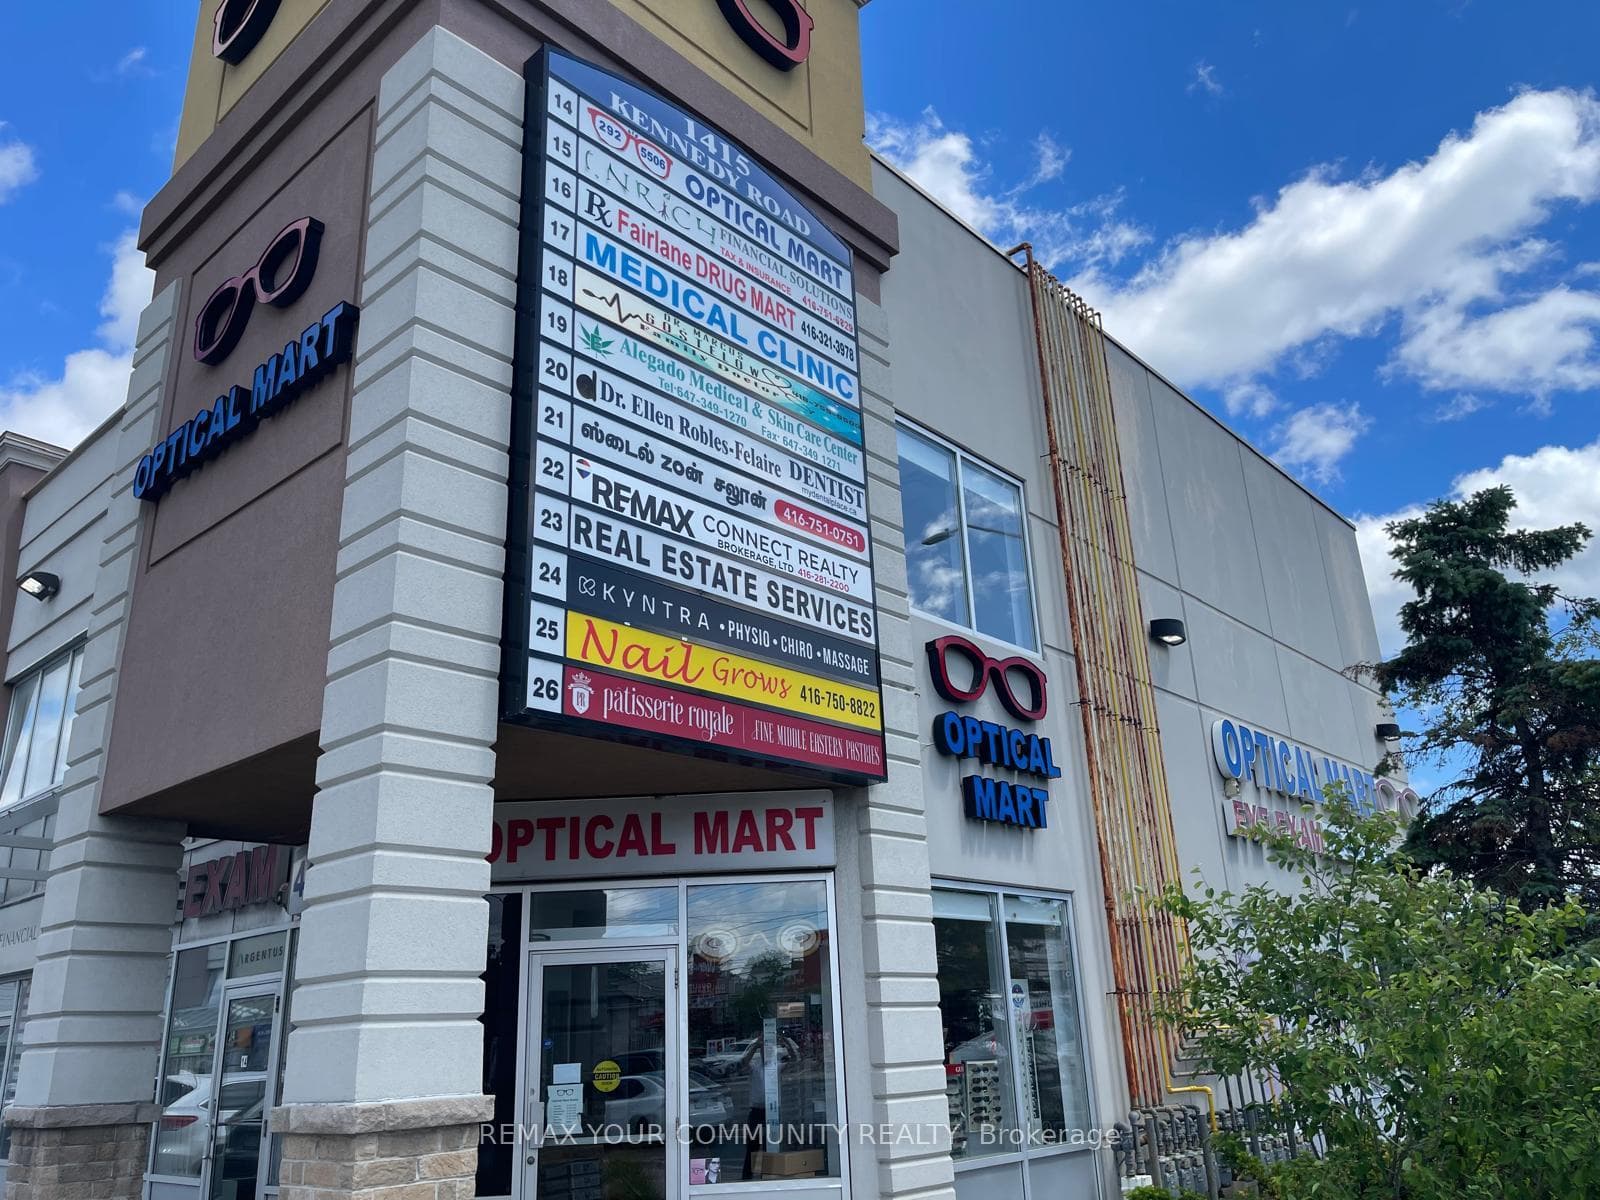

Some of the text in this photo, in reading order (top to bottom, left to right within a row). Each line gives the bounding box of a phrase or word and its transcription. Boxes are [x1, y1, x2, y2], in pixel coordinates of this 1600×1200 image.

[554, 93, 572, 115] 14
[553, 136, 571, 158] 15
[599, 120, 621, 141] 292
[641, 147, 666, 170] 5506
[610, 91, 810, 236] KENNEDY ROAD
[685, 117, 750, 177] 1415
[553, 177, 571, 199] 16
[551, 220, 570, 241] 17
[685, 174, 842, 289] OPTICAL MART
[549, 265, 568, 286] 18
[617, 209, 692, 271] Fairlane
[696, 254, 747, 303] DRUG
[751, 286, 796, 331] MART
[720, 246, 736, 263] TAX
[738, 257, 745, 267] &
[746, 262, 792, 296] INSURANCE
[720, 228, 787, 279] FINANCIAL
[790, 271, 853, 320] SOLUTIONS
[548, 312, 567, 333] 19
[586, 233, 853, 399] MEDICAL CLINIC
[545, 358, 568, 381] 20
[133, 301, 350, 498] OPTICAL MART
[544, 406, 563, 429] 21
[620, 338, 858, 465] Alegado Medical & Skin Care Center
[542, 457, 564, 480] 22
[600, 380, 864, 509] Dr. Ellen Robles-Felaire DENTIST
[541, 509, 562, 532] 23
[784, 507, 859, 548] 416-751-0751
[539, 562, 561, 585] 24
[703, 515, 792, 561] CONNECT
[798, 549, 859, 584] REALTY
[574, 513, 872, 638] REAL ESTATE SERVICES
[778, 560, 794, 573] LTD
[798, 568, 849, 593] 416-281-2200
[536, 617, 558, 641] 25
[602, 582, 869, 676] KYNTRA PHYSIO CHIRO MASSAGE
[533, 677, 559, 700] 26
[581, 619, 876, 719] Nail Grows 416-750-8822
[688, 705, 734, 742] royale
[753, 719, 774, 744] FINE
[777, 724, 807, 751] MIDDLE
[942, 711, 1062, 779] OPTICAL
[1219, 719, 1324, 803] OPTICAL
[970, 775, 1050, 828] MART
[693, 807, 824, 855] MART
[183, 844, 277, 918] EXAM
[0, 926, 37, 948] INANCIAL
